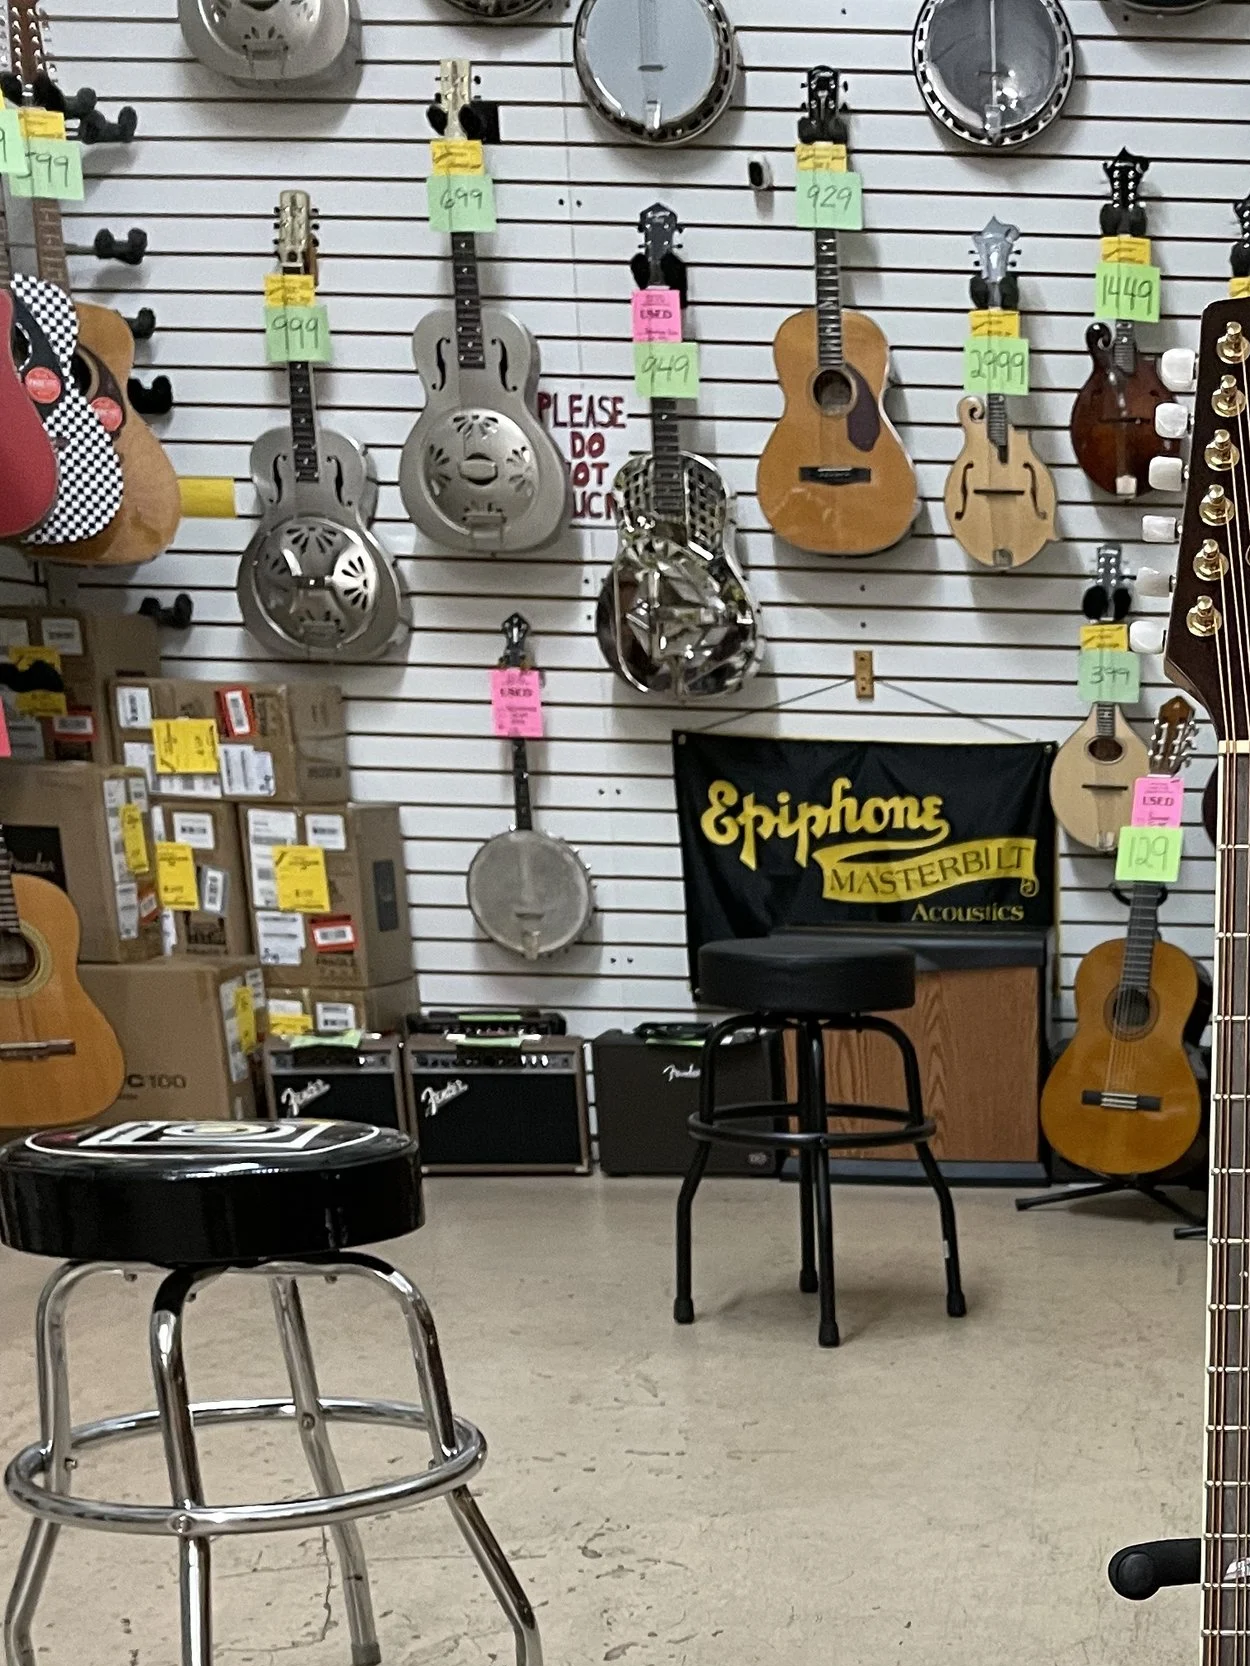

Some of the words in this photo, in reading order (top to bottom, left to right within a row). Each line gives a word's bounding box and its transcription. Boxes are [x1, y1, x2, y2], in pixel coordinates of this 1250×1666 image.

[440, 186, 482, 209] 699
[807, 184, 852, 210] 929
[1102, 274, 1153, 316] 1449
[271, 315, 319, 350] 999
[641, 354, 690, 385] 949
[970, 349, 1024, 384] 2999
[537, 391, 626, 428] PLEASE
[570, 431, 605, 458] DO
[1142, 796, 1174, 806] USED
[700, 776, 950, 872] Epiphone
[828, 846, 1031, 895] MASTERBILT
[1128, 835, 1170, 871] 129
[281, 1078, 332, 1117] Fender
[420, 1079, 469, 1118] Fender
